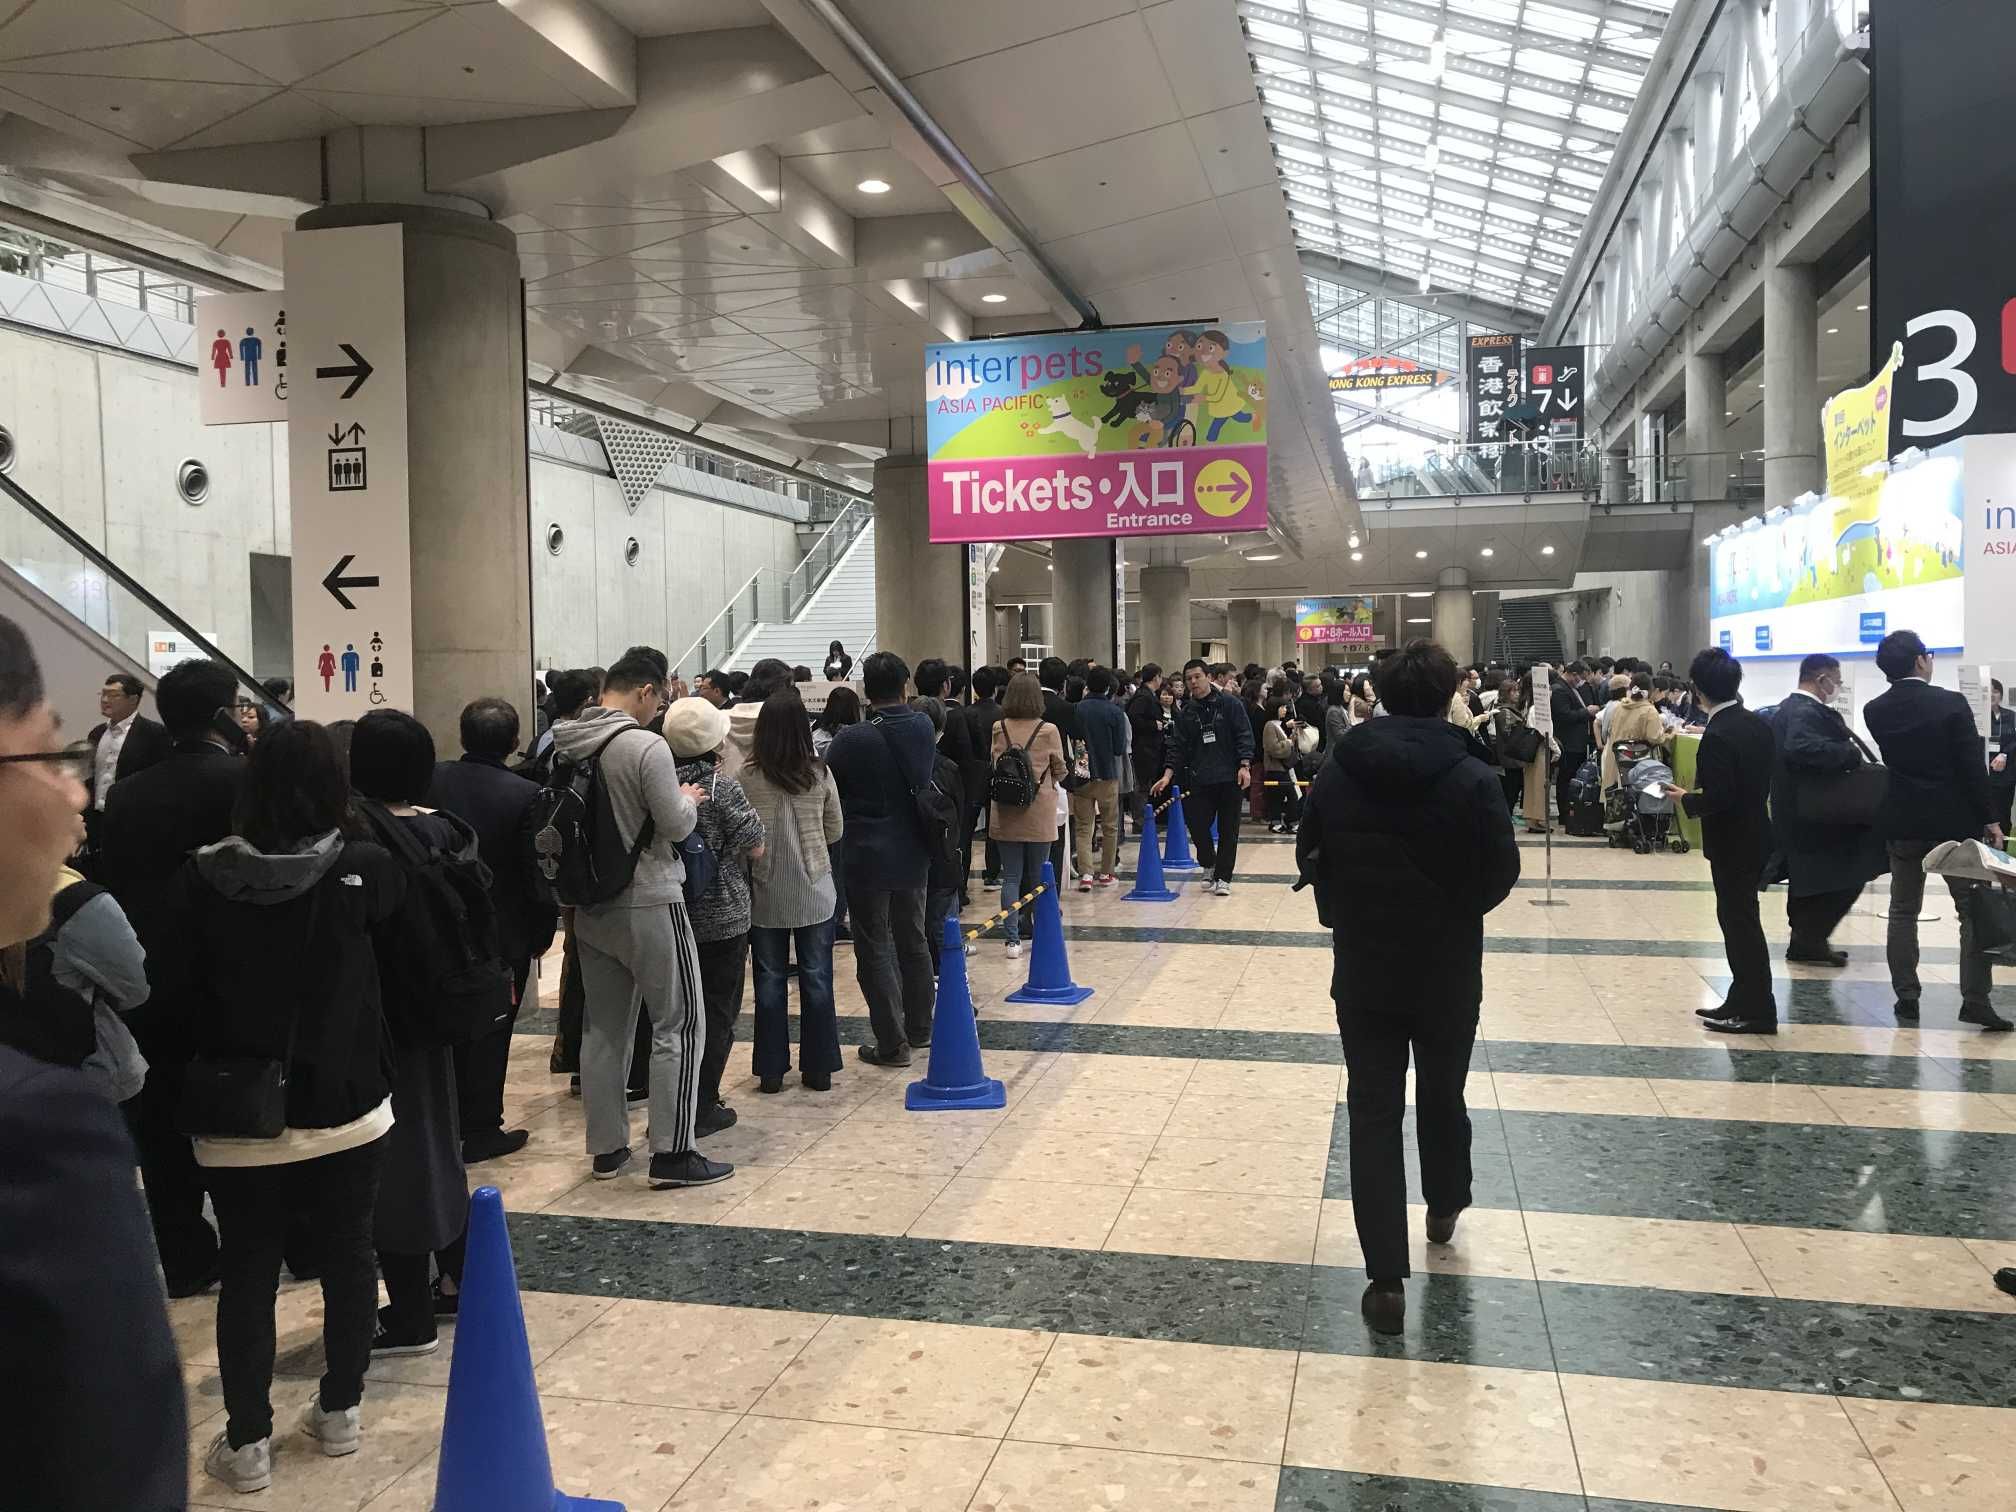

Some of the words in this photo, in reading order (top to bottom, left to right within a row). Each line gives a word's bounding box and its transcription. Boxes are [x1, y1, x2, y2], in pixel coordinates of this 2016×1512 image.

[1472, 335, 1514, 346] EXPRESS
[935, 345, 1104, 390] interpets
[1902, 309, 1978, 437] 3
[1355, 376, 1385, 388] KONG
[1387, 374, 1433, 386] EXPRESS
[937, 395, 977, 414] ASIA
[982, 393, 1043, 412] PACIFIC
[1107, 511, 1193, 528] Entrance
